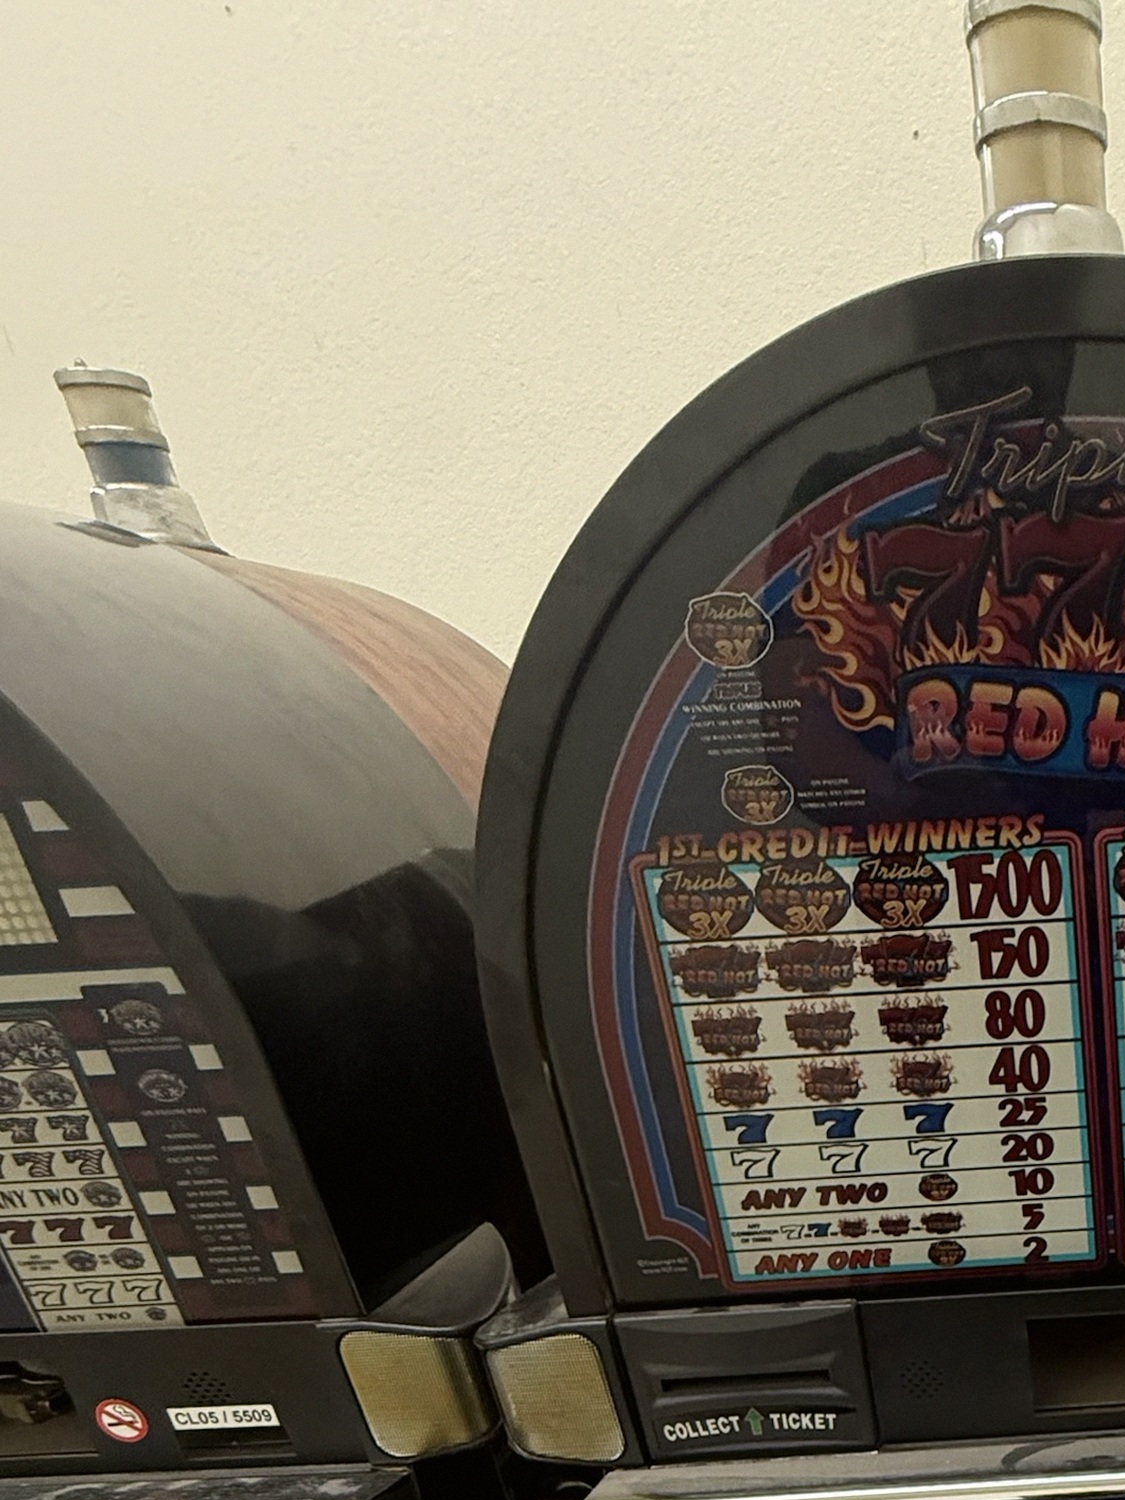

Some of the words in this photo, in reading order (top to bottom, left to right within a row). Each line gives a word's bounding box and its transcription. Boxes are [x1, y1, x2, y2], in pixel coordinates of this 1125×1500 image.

[682, 701, 727, 713] WINNING
[729, 699, 802, 712] COMBINATION
[906, 680, 1071, 766] RED
[656, 835, 700, 866] 1ST
[718, 828, 852, 861] CREDIT
[866, 814, 1045, 853] WINNERS
[947, 847, 1063, 921] 1500
[970, 926, 1050, 980] 150
[983, 988, 1046, 1040] 80
[988, 1044, 1051, 1093] 40
[998, 1096, 1047, 1128] 25
[1000, 1132, 1055, 1163] 20
[32, 1187, 79, 1208] TWO
[741, 1187, 807, 1210] ANY
[815, 1182, 888, 1206] TWO
[1007, 1167, 1055, 1196] 10
[1020, 1204, 1045, 1230] 5
[754, 1253, 819, 1275] ANY
[827, 1248, 892, 1270] ONE
[1022, 1236, 1049, 1264] 2
[56, 1314, 85, 1324] ANY
[95, 1311, 132, 1322] TWO
[175, 1412, 219, 1425] CL05
[234, 1409, 272, 1423] 5509
[663, 1416, 741, 1442] COLLECT
[770, 1413, 836, 1431] TICKET
